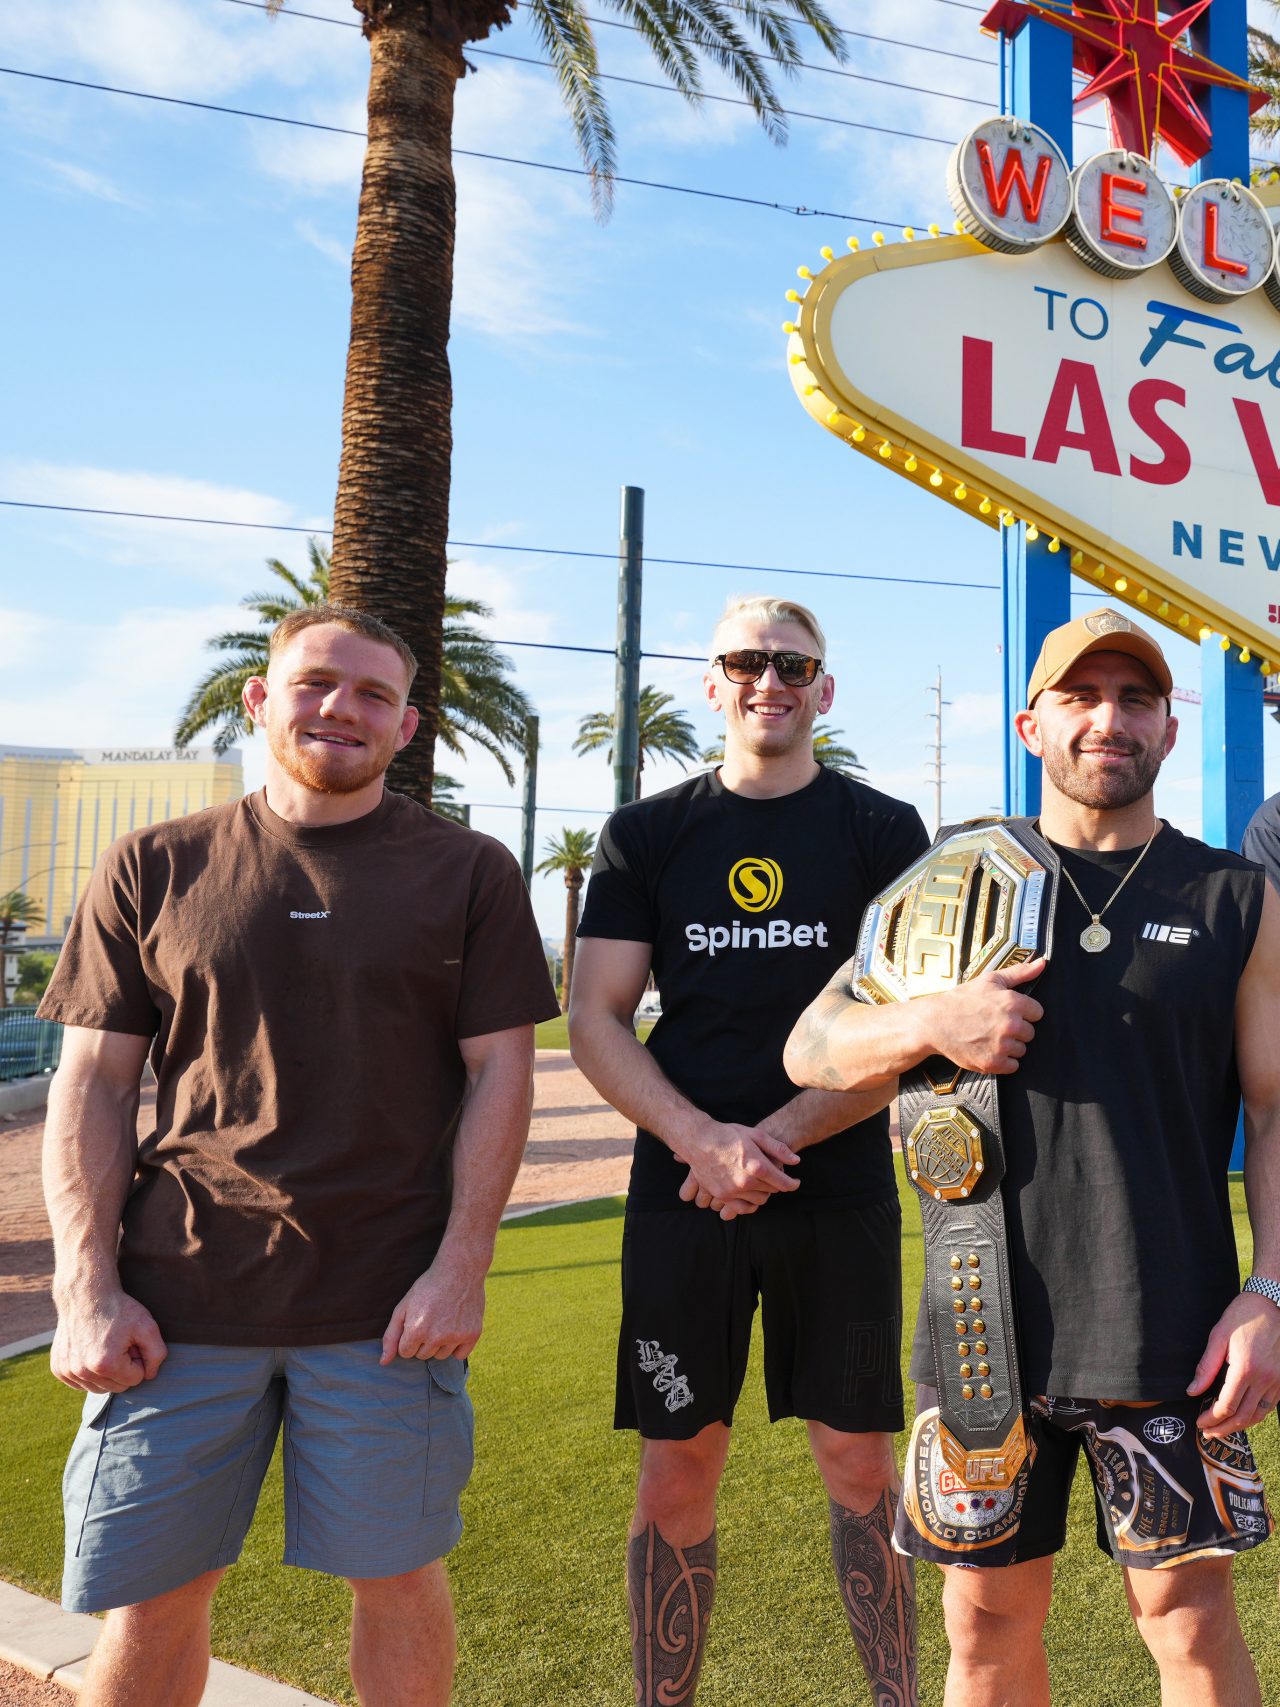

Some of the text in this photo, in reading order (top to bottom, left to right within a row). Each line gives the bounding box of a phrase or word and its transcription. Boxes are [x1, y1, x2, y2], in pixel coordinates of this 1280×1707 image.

[1033, 285, 1110, 341] TO
[960, 336, 1192, 486] LAS
[101, 750, 199, 762] MANDALAY BAY
[685, 919, 829, 957] SpinBet
[920, 1422, 937, 1471] FEAT
[965, 1457, 1006, 1484] UFC
